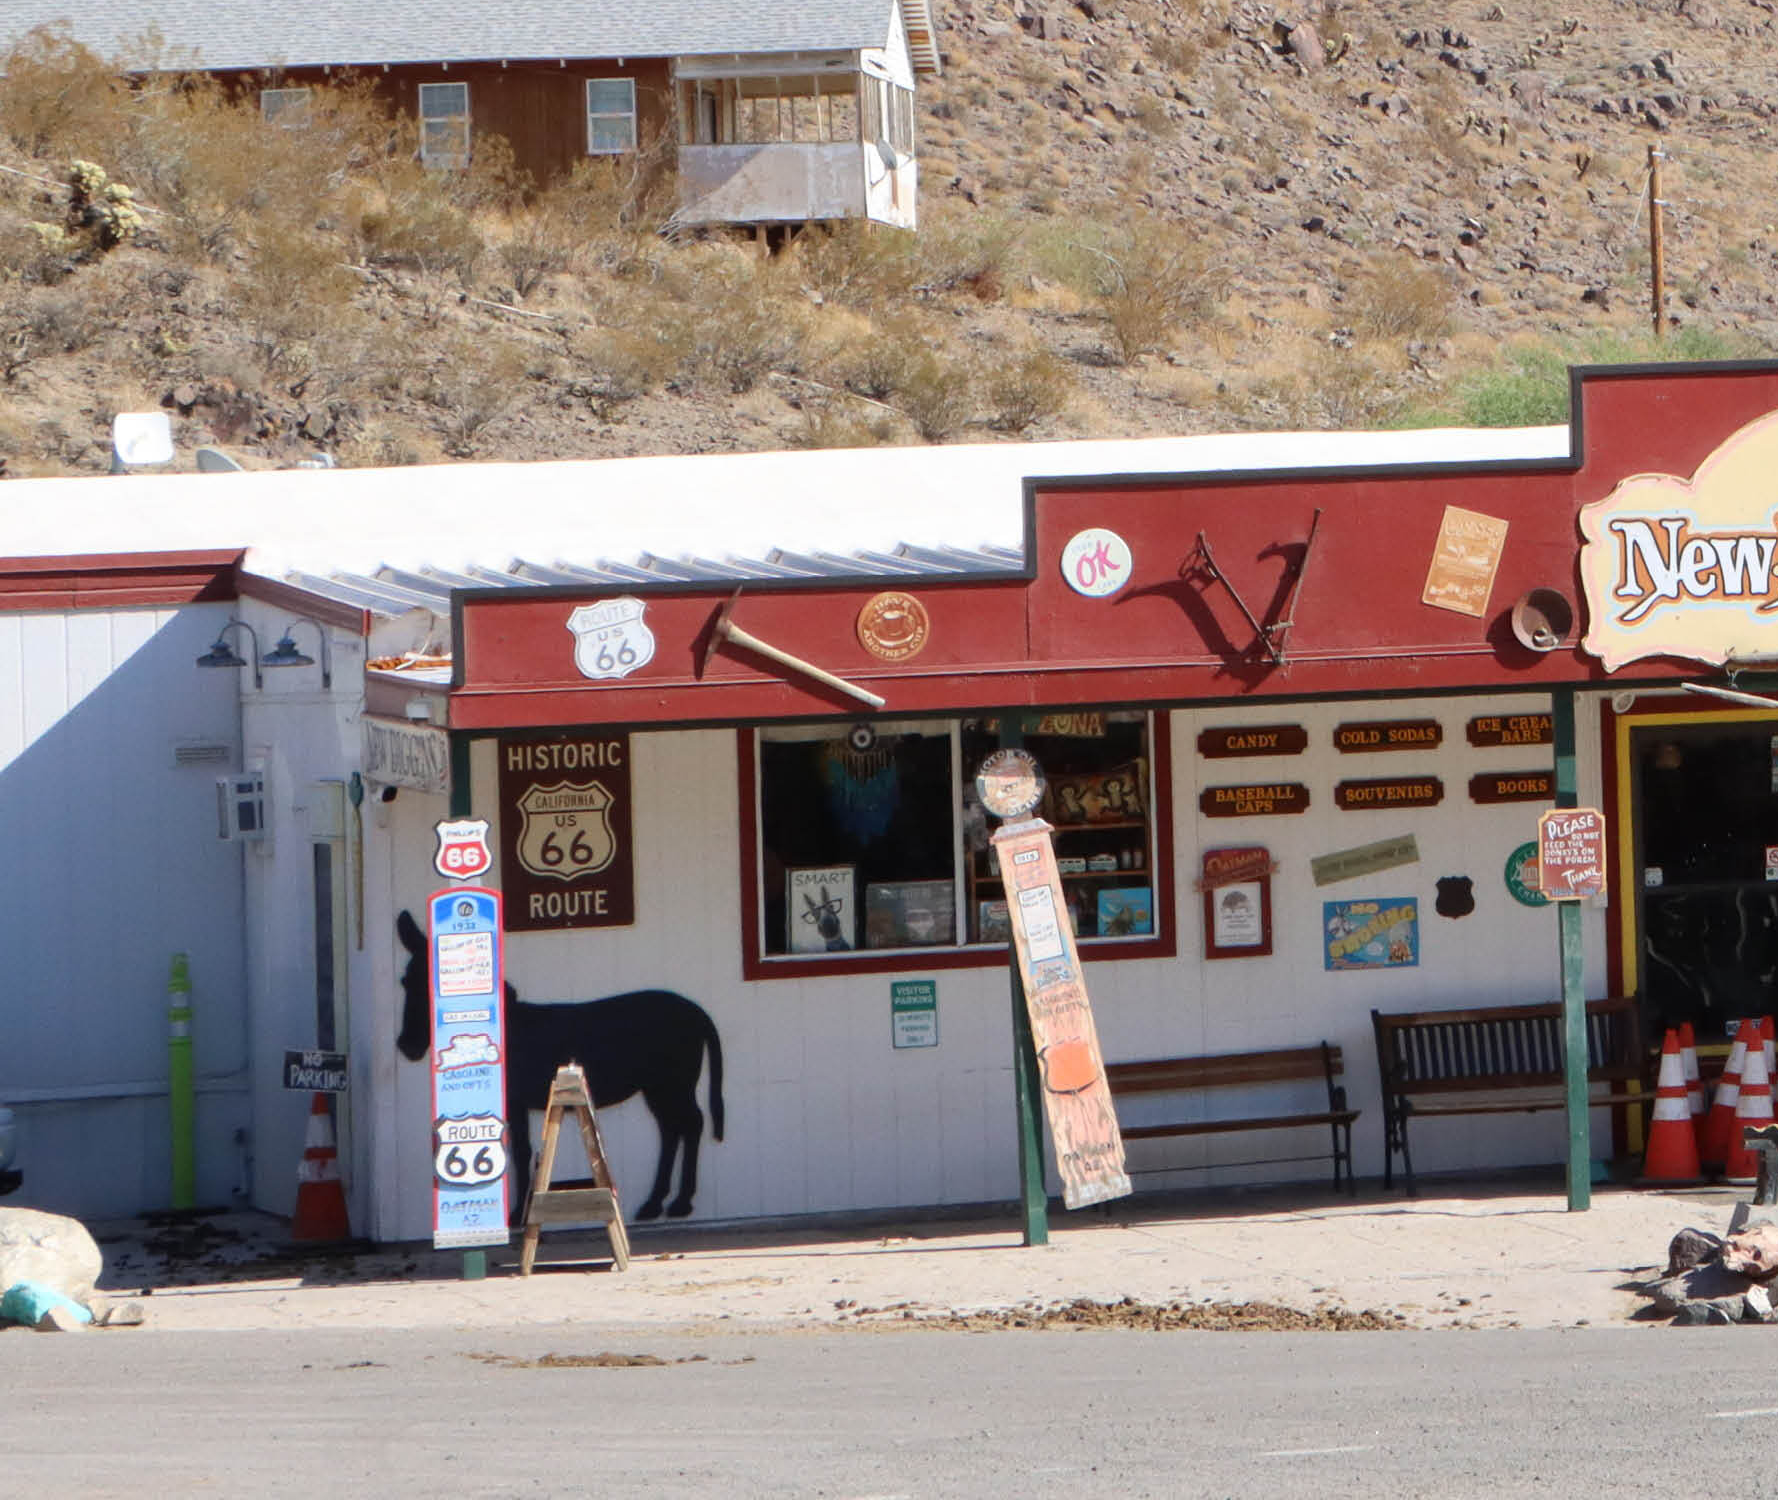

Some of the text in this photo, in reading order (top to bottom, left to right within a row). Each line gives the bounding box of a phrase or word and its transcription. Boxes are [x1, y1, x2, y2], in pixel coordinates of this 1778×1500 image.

[1076, 539, 1121, 588] OK
[1612, 516, 1777, 622] New
[581, 603, 635, 629] ROUTE
[599, 627, 624, 642] US
[595, 639, 637, 672] 66
[1477, 715, 1553, 732] ICE CREA
[1226, 734, 1279, 748] CANDY
[1341, 727, 1436, 744] COLD SODAS
[1501, 729, 1541, 744] BARS
[507, 741, 622, 771] HISTORIC
[1215, 786, 1295, 802] BASEBALL
[1345, 785, 1433, 802] SOUVENIRS
[1496, 779, 1548, 795] BOOKS
[534, 795, 596, 810] CALIFORNIA
[1235, 800, 1274, 814] CAPS
[555, 814, 577, 828] US
[1545, 814, 1595, 840] PLEASE
[540, 829, 594, 867] 66
[446, 847, 481, 868] 66
[794, 871, 849, 886] SMART
[1561, 865, 1602, 891] THANK
[529, 890, 609, 919] ROUTE
[303, 1051, 323, 1065] NO
[289, 1064, 347, 1089] PARKING
[448, 1124, 497, 1140] ROUTE
[444, 1146, 494, 1178] 66
